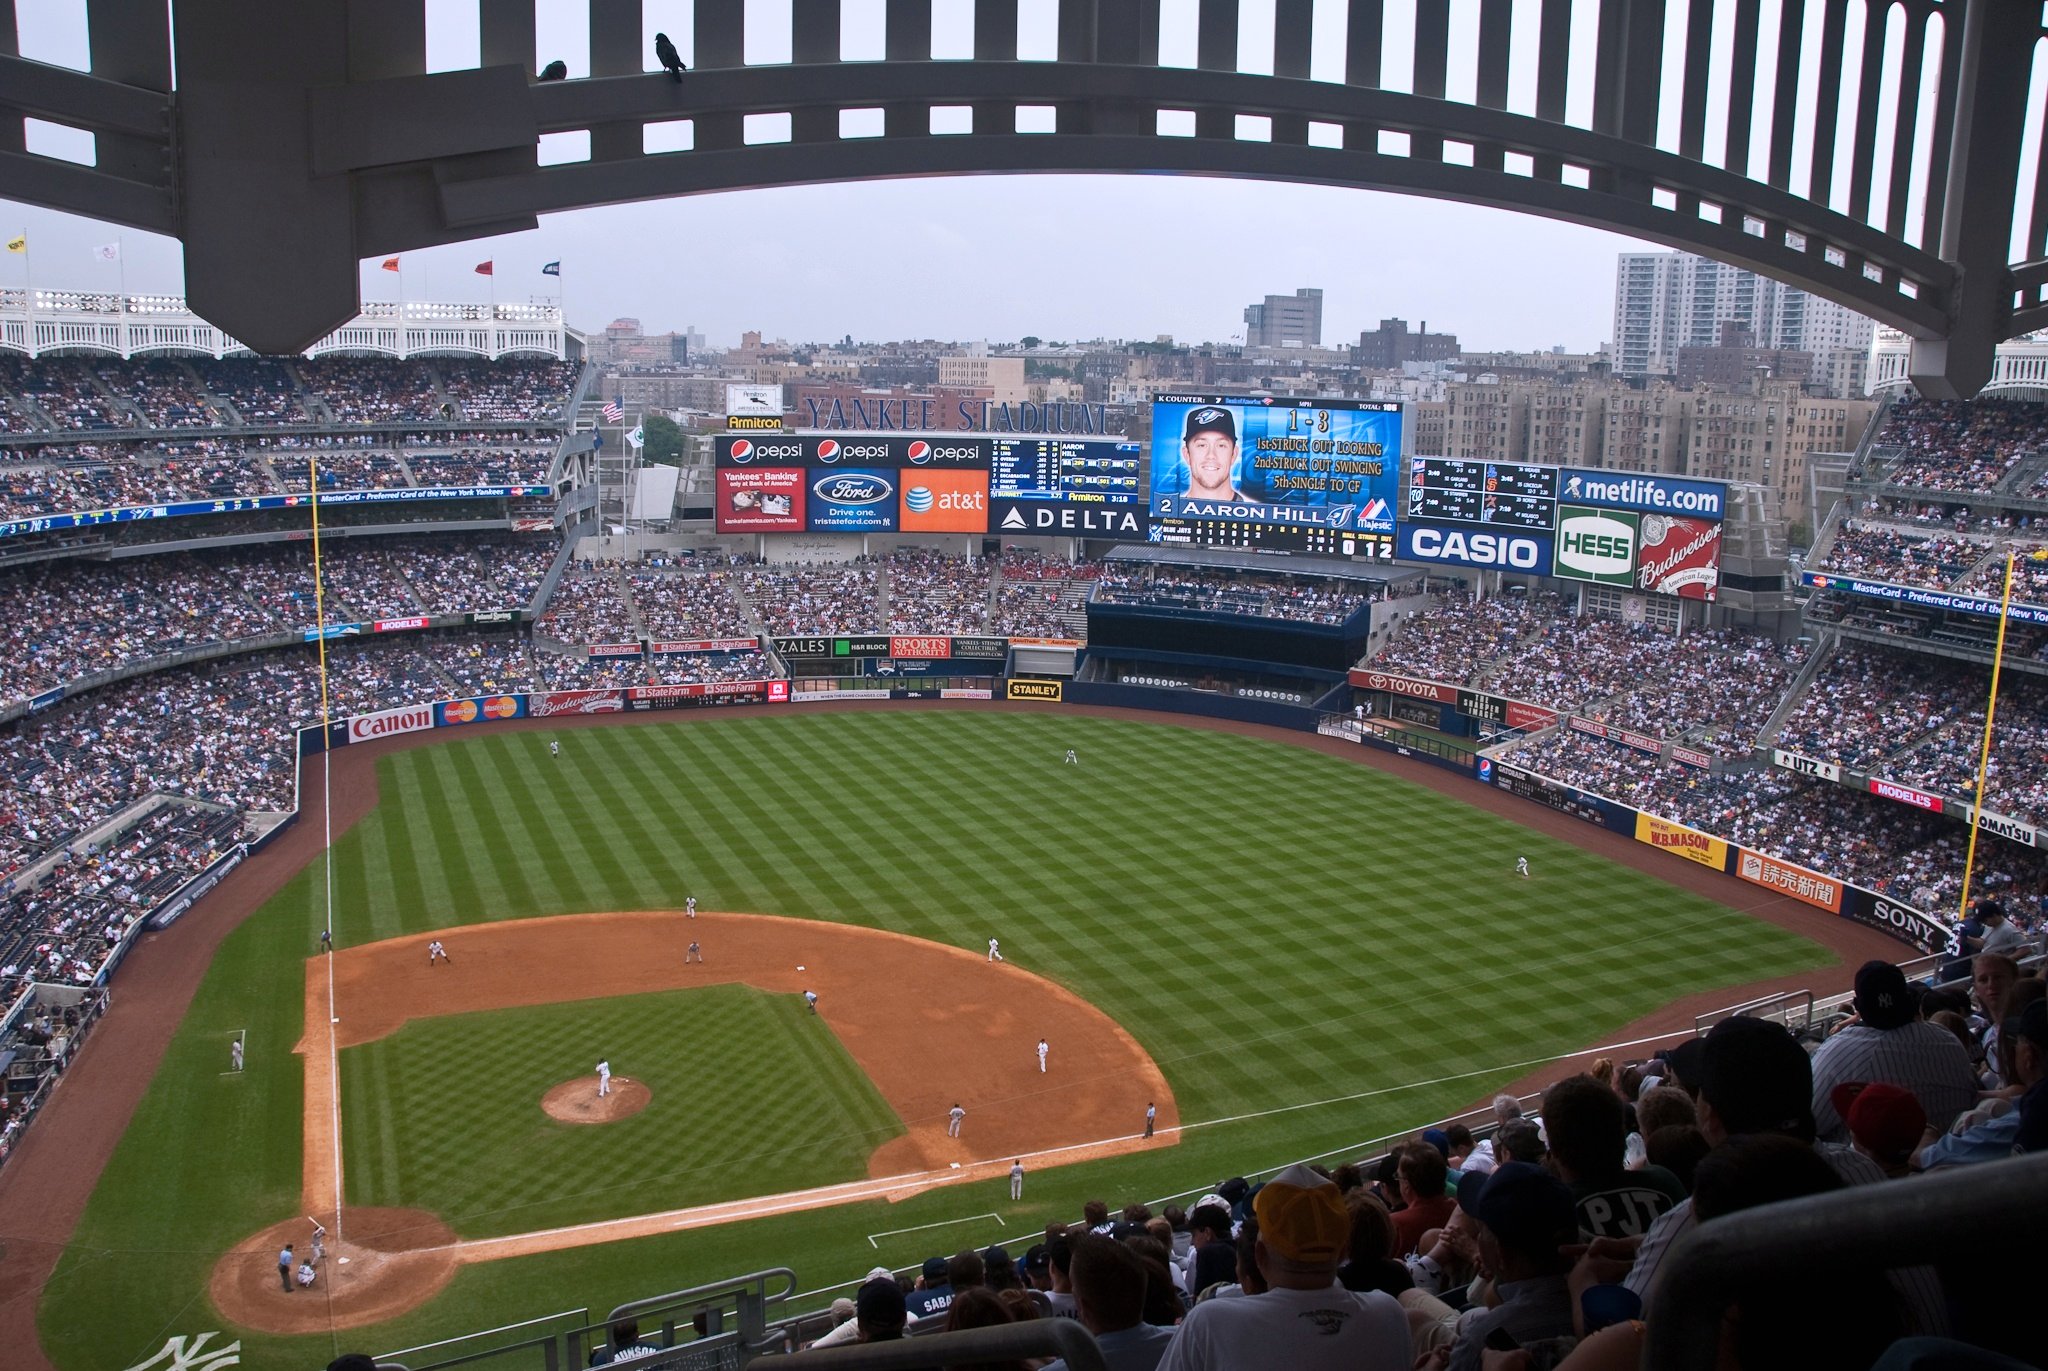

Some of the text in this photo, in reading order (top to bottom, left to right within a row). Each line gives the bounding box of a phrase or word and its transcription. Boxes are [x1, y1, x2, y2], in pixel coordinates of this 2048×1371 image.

[729, 416, 782, 428] Armitron
[806, 398, 1108, 434] YANKEE STADIUM
[1290, 408, 1328, 432] 1 3
[756, 443, 802, 460] pepsi
[843, 444, 889, 460] pepsi
[933, 446, 978, 461] pepsi
[1312, 440, 1334, 453] OUT
[1336, 441, 1382, 456] LOOKING
[1311, 459, 1334, 472] OUT
[1335, 460, 1382, 475] SWINGING
[764, 472, 798, 482] Banking
[832, 480, 874, 499] Ford
[1330, 478, 1345, 492] TO
[1348, 480, 1360, 493] CF
[321, 494, 360, 502] MasterCard
[938, 490, 983, 510] at&t
[1068, 492, 1105, 502] Armitron
[1585, 479, 1718, 512] metlife.com
[1160, 500, 1324, 523] 2 AARON HILL
[10, 520, 51, 534] 3 3
[814, 518, 882, 526] tristateford.com
[1036, 508, 1138, 532] DELTA
[1358, 519, 1392, 531] Majestic
[1366, 542, 1374, 557] 1
[1380, 543, 1392, 558] 2
[1412, 528, 1538, 568] CASIO
[1564, 531, 1629, 560] HESS
[1638, 523, 1722, 589] Budweiser
[1668, 572, 1716, 588] American Lager
[1852, 582, 1900, 598] MasterCard
[1908, 592, 1950, 606] Preferred
[1952, 598, 1973, 610] Card
[1976, 602, 1987, 612] of
[2007, 606, 2032, 620] New
[382, 619, 423, 630] MODELL'S
[779, 640, 825, 652] ZALES
[894, 639, 946, 650] SPORTS
[1014, 685, 1056, 695] STANLEY
[1388, 678, 1438, 699] TOYOTA
[539, 690, 610, 716] Budweiser
[1464, 699, 1499, 713] SHARPER
[1475, 694, 1488, 704] THE
[445, 709, 476, 717] MasterCard
[484, 704, 516, 712] MasterCard
[1469, 708, 1493, 719] IMAGE
[353, 710, 430, 737] Canon
[1572, 718, 1604, 734] MODELL'S
[1624, 734, 1658, 750] MODELL'S
[1673, 748, 1709, 766] MODELL'S
[1498, 766, 1526, 780] GATORADE
[1793, 758, 1818, 774] UTZ
[1878, 783, 1932, 808] MODELL'S
[1762, 862, 1834, 905] 読売新聞
[1874, 901, 1934, 942] SONY
[1584, 1191, 1660, 1236] PJT
